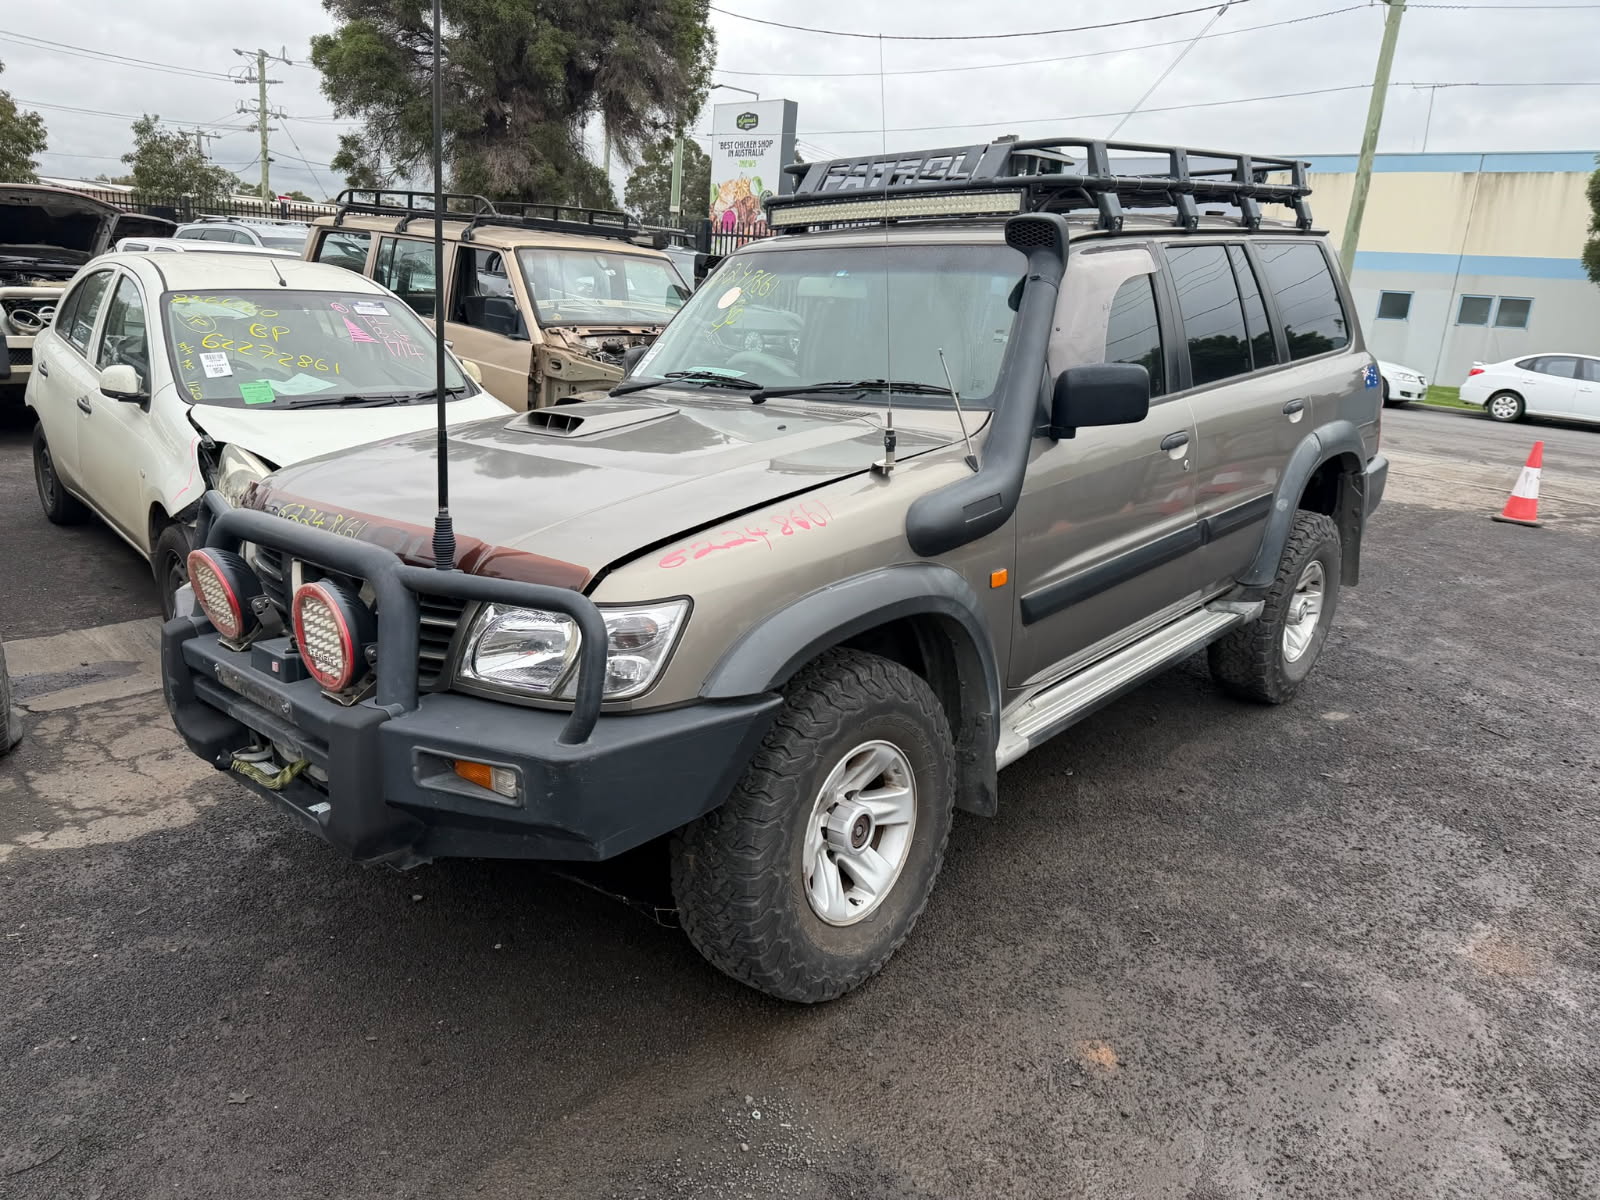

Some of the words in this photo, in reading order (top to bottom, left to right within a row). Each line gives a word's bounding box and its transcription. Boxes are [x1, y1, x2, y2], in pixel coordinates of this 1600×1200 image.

[734, 140, 757, 149] CHICKEN
[758, 139, 773, 148] SHOP
[728, 149, 734, 157] IN
[822, 152, 970, 191] PATROL
